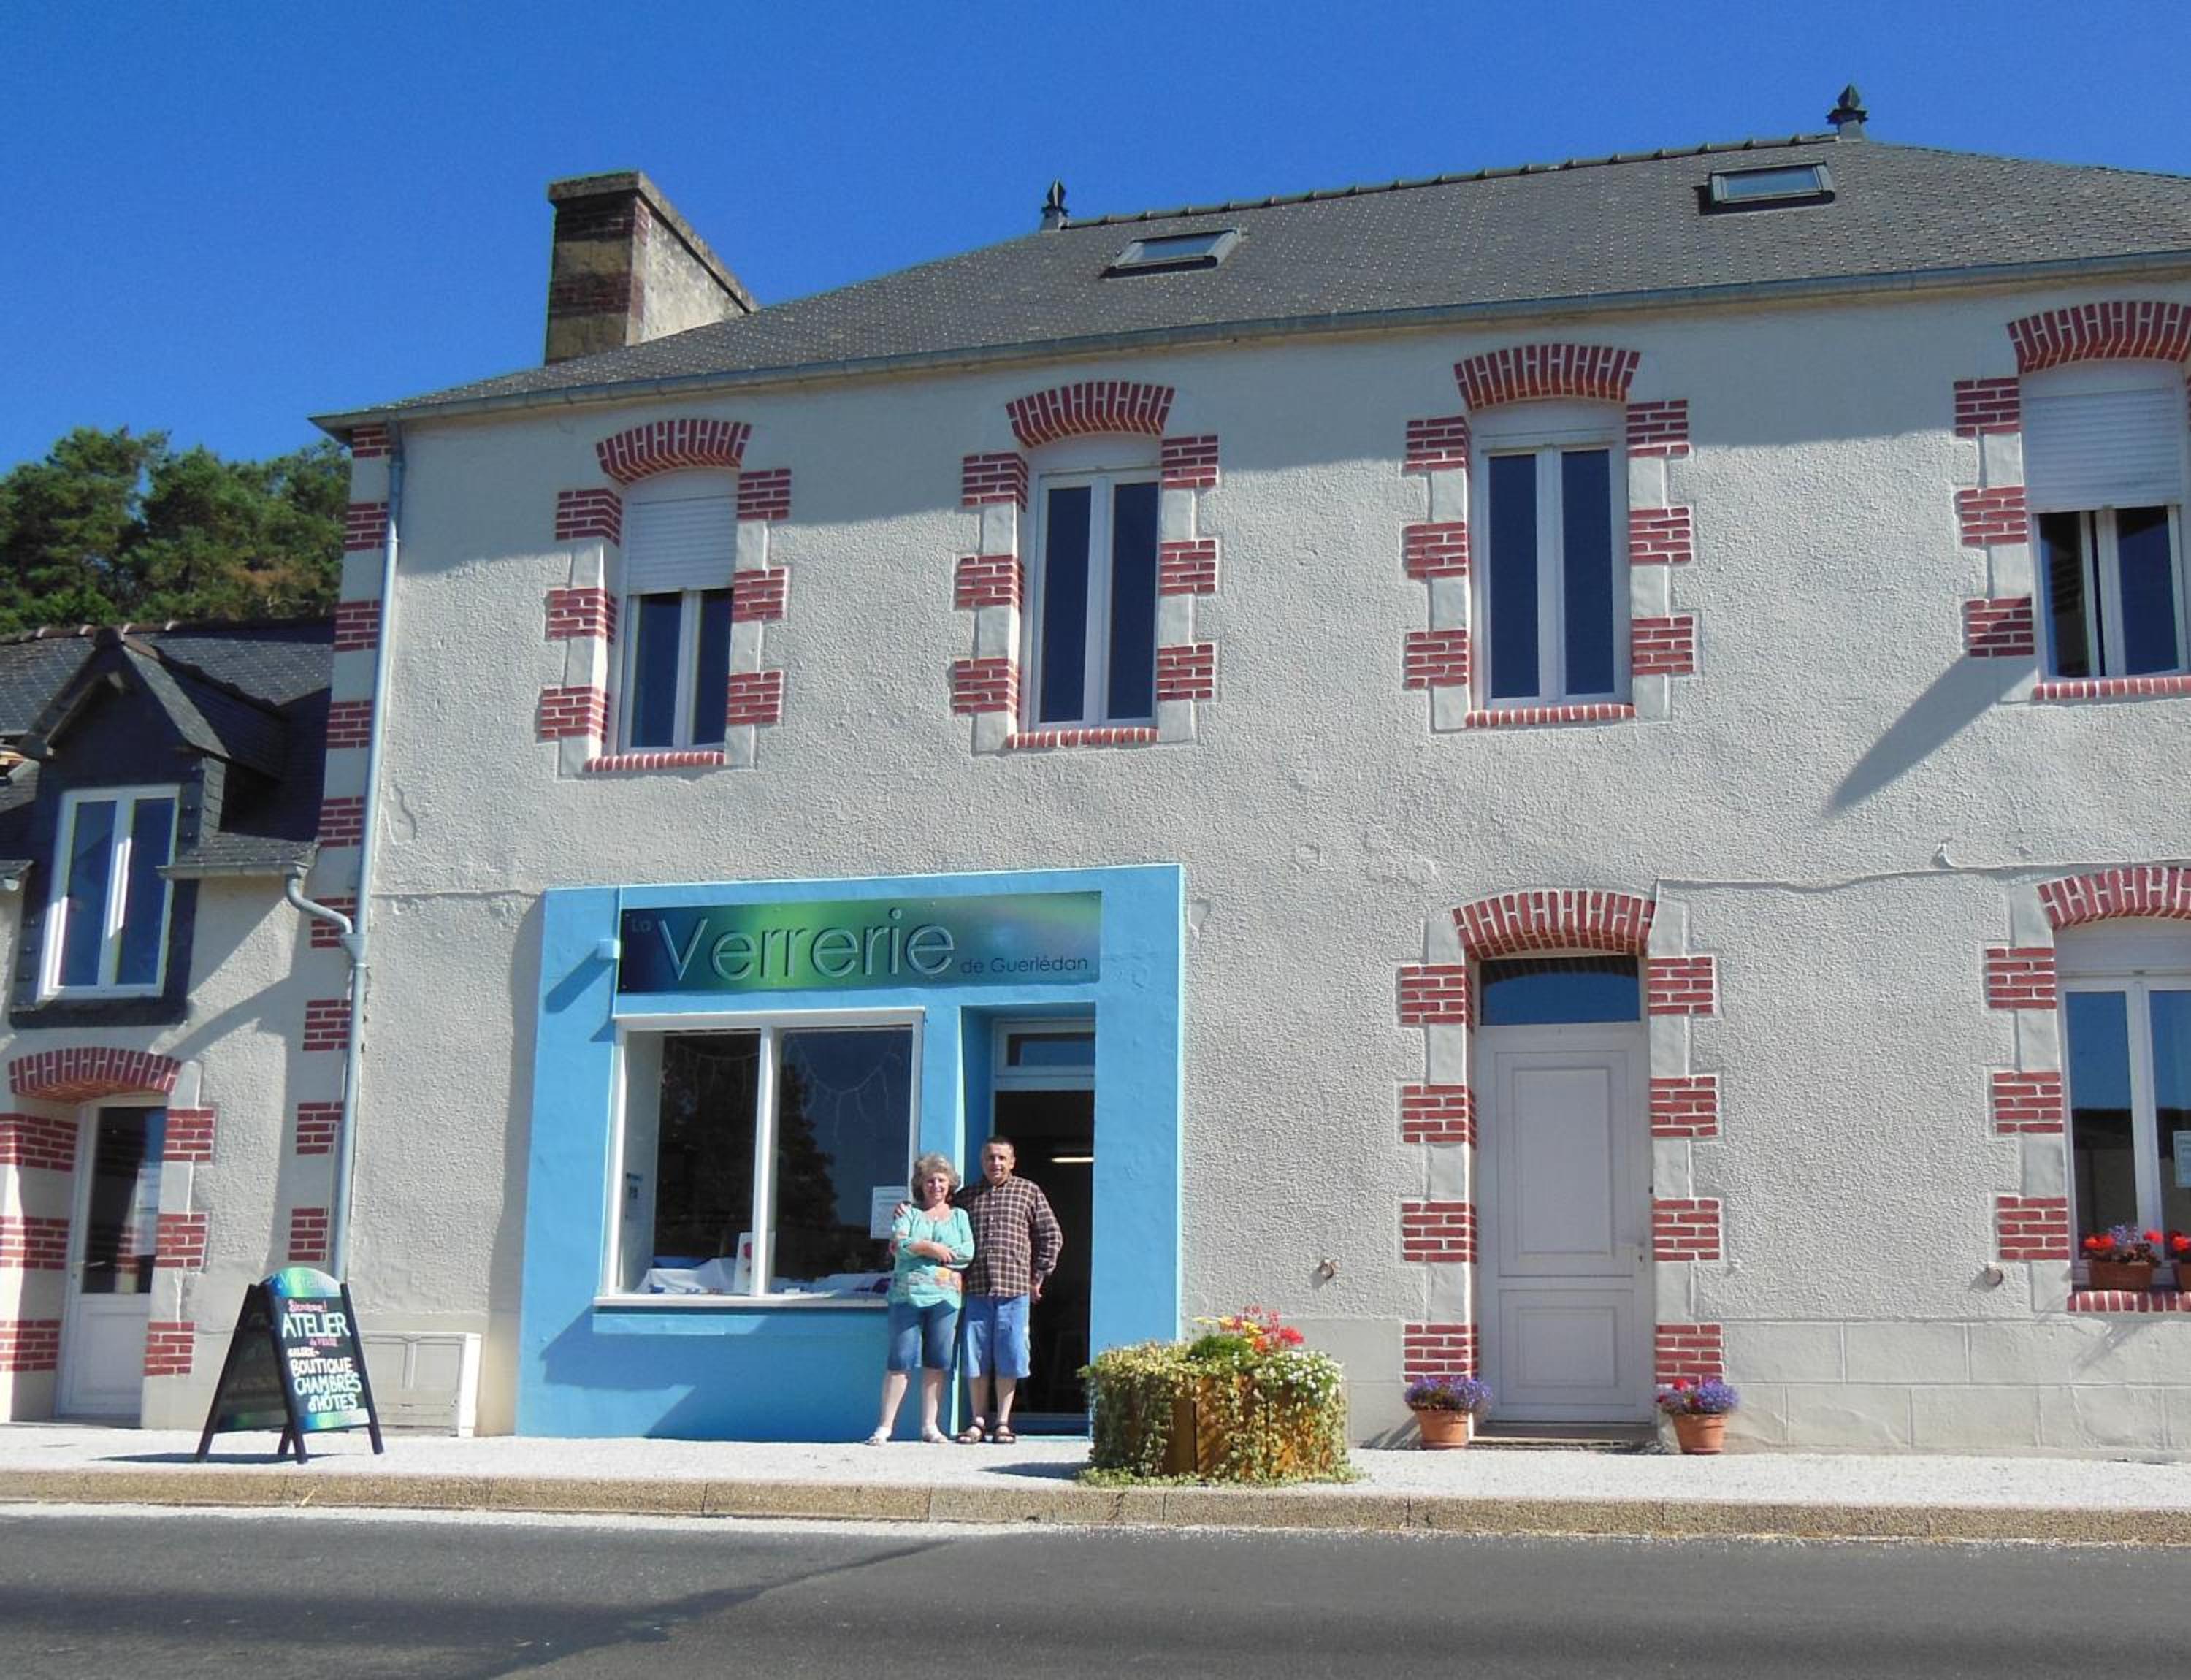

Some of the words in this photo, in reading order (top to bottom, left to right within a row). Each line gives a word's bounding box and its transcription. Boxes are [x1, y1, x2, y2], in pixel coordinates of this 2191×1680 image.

[631, 919, 653, 934] La
[659, 908, 955, 981] Verrerie
[960, 959, 984, 974] de
[990, 954, 1088, 973] Guerlédan
[281, 1312, 351, 1338] ATELIER
[290, 1357, 353, 1378] BOUTIQUE
[294, 1372, 362, 1396] CHAMBRES
